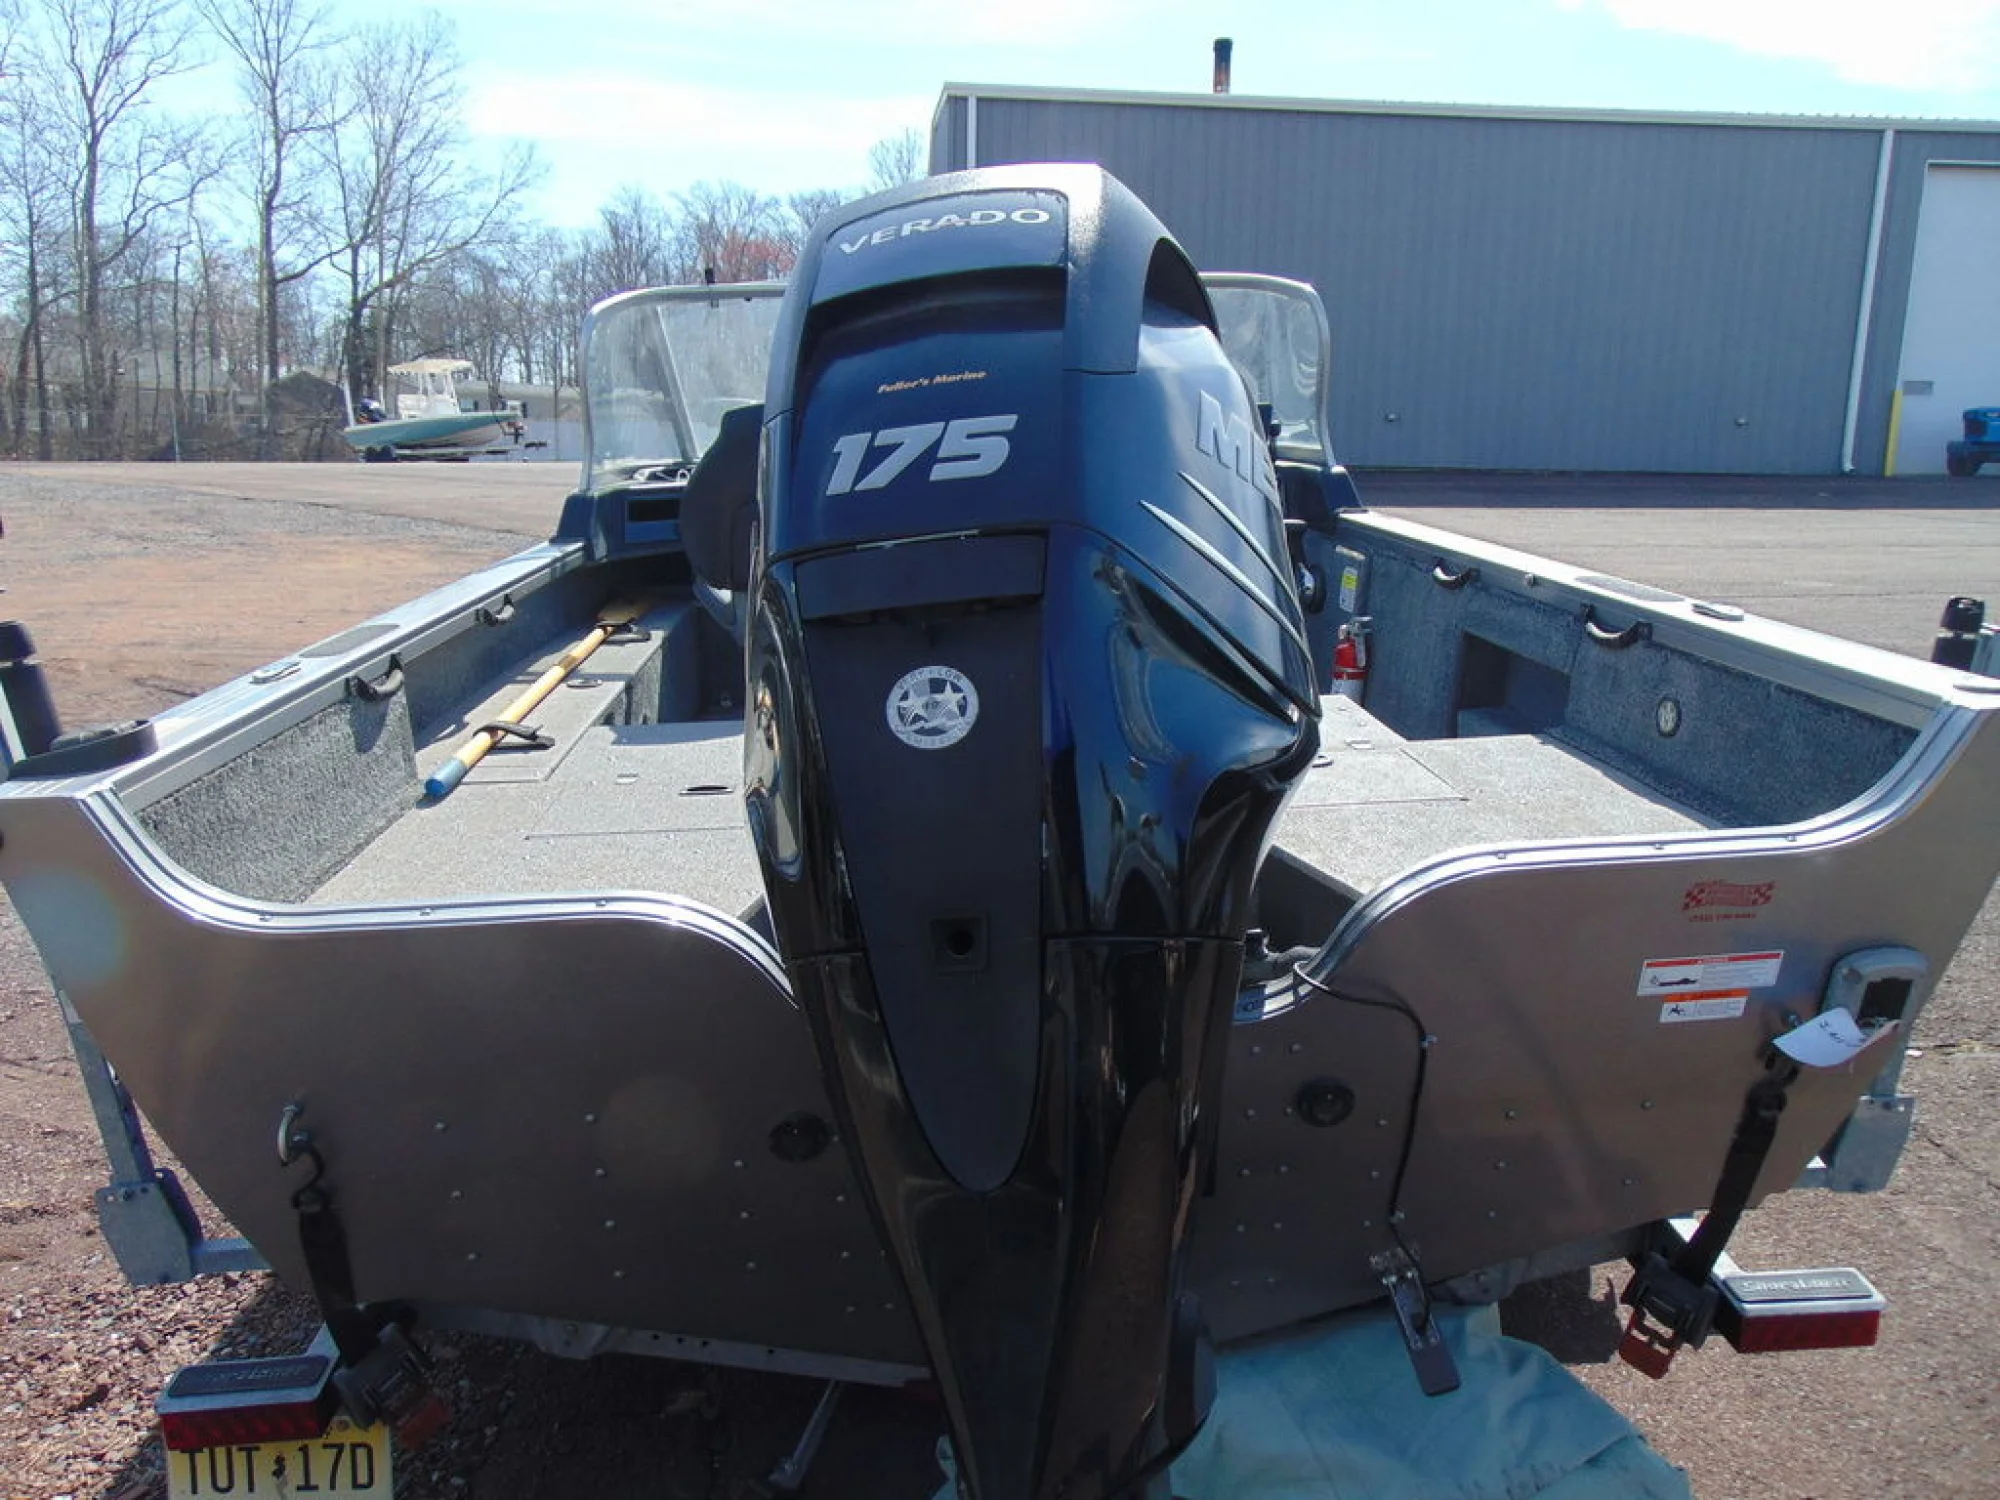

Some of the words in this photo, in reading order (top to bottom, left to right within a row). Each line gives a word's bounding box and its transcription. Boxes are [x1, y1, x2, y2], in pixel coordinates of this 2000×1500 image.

[840, 208, 1050, 254] VERADO
[933, 370, 988, 384] Marine
[826, 414, 1018, 496] 175
[180, 1447, 261, 1495] TUT
[296, 1443, 375, 1492] 17D
